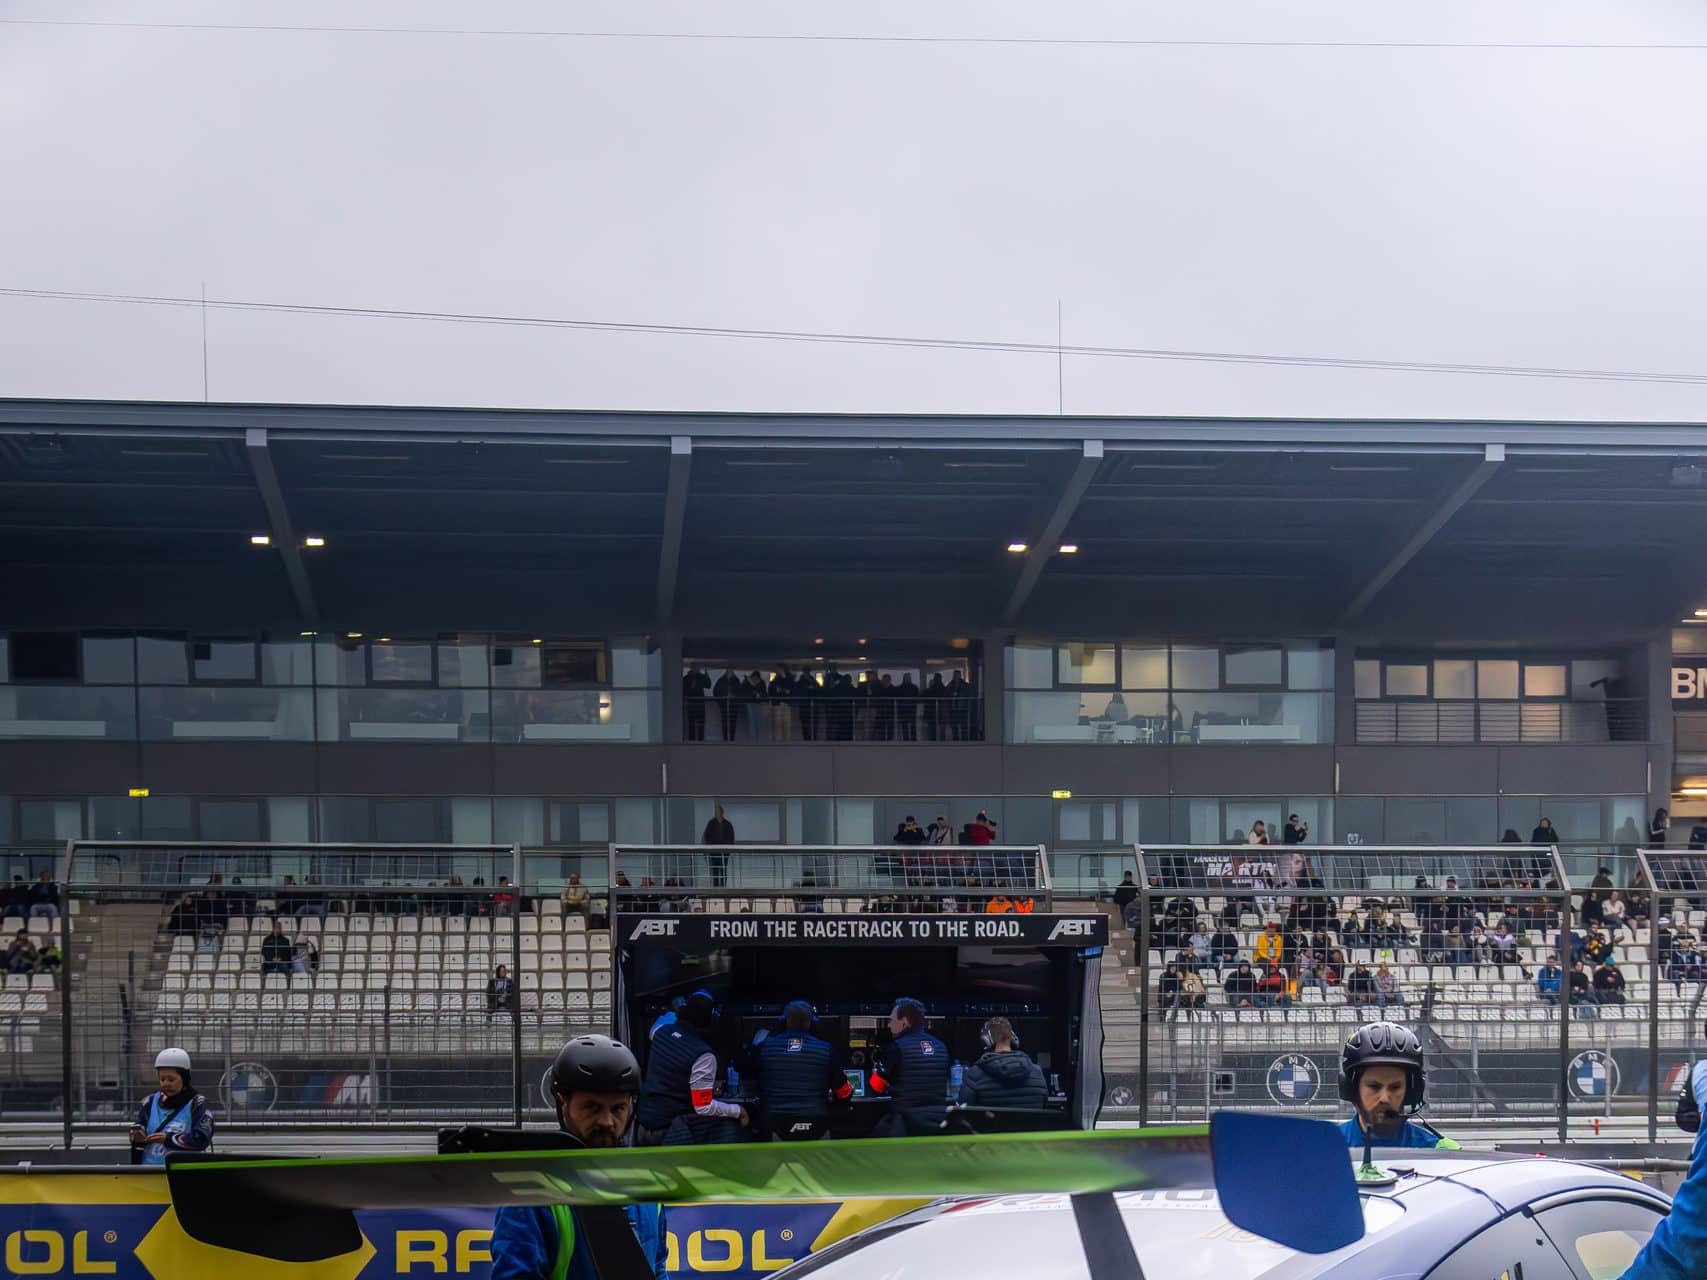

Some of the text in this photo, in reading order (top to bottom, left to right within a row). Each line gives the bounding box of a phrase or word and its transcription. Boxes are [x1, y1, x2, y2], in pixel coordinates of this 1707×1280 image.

[629, 919, 680, 940] ABT
[710, 920, 1025, 938] FROM THE RACETRACK TO THE ROAD.
[1048, 919, 1097, 940] ABT
